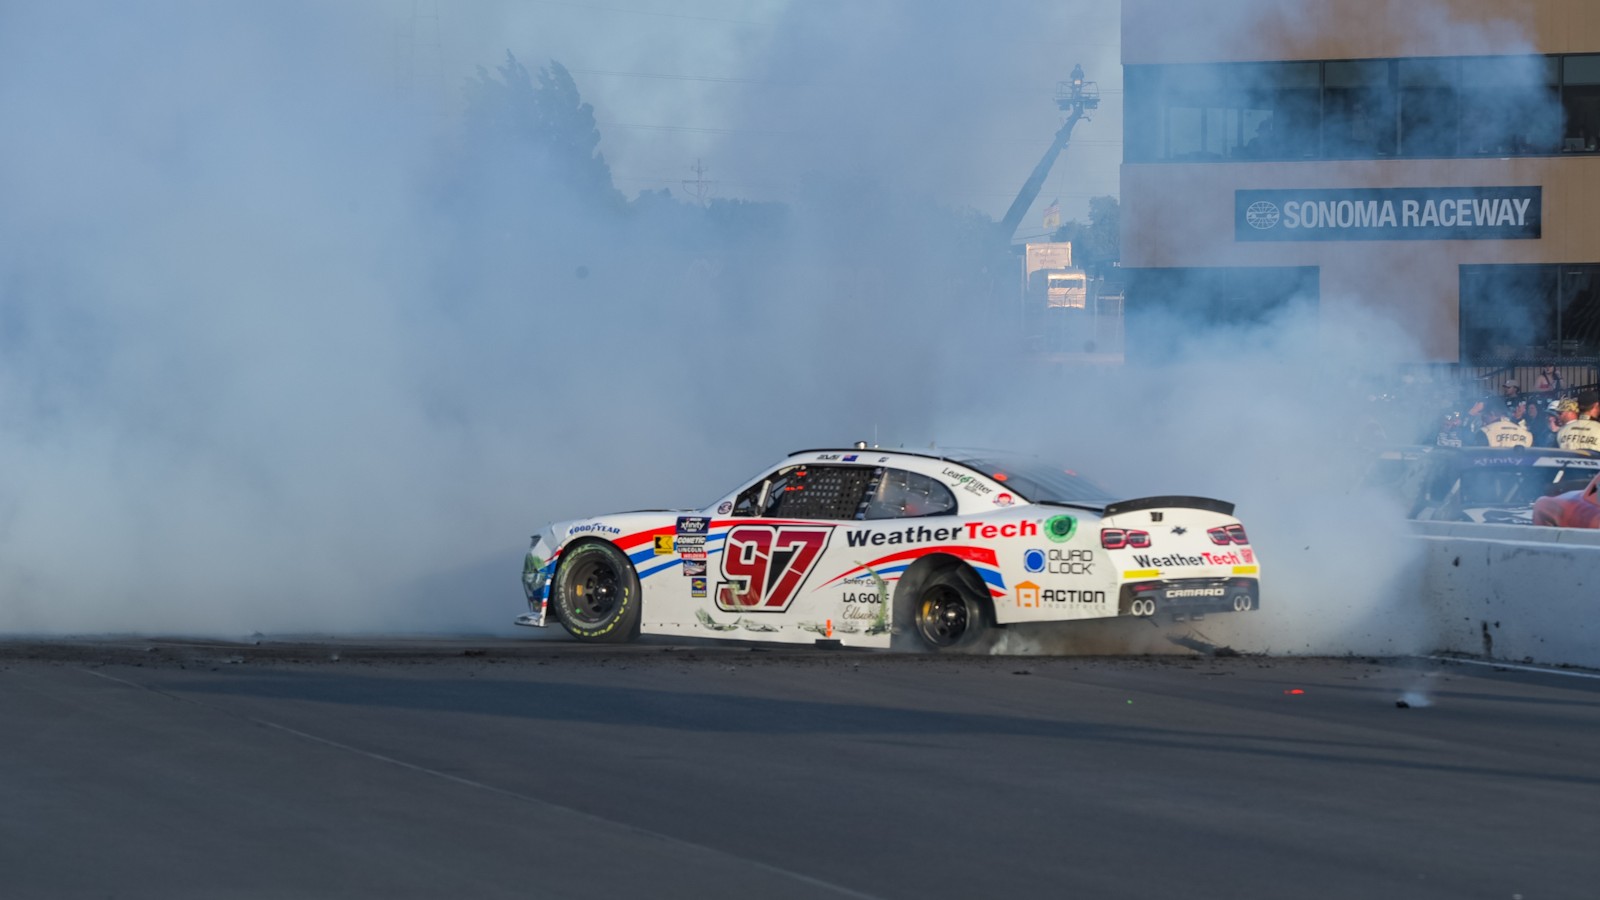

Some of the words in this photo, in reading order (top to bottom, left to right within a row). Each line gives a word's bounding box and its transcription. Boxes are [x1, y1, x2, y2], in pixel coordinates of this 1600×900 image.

[1283, 200, 1397, 228] SONOMA
[1402, 198, 1531, 227] RACEWAY
[1560, 433, 1599, 446] OFFICIAL
[680, 519, 706, 531] xfinity
[677, 536, 706, 545] COMETIC
[846, 520, 1037, 548] WeatherTech
[1048, 549, 1094, 562] QUAD
[1133, 551, 1240, 568] WeatherTech
[715, 525, 836, 613] 97
[1048, 562, 1094, 575] LOCK
[843, 592, 856, 603] LA
[1041, 589, 1106, 604] ACTION
[1166, 588, 1225, 598] CAMARO
